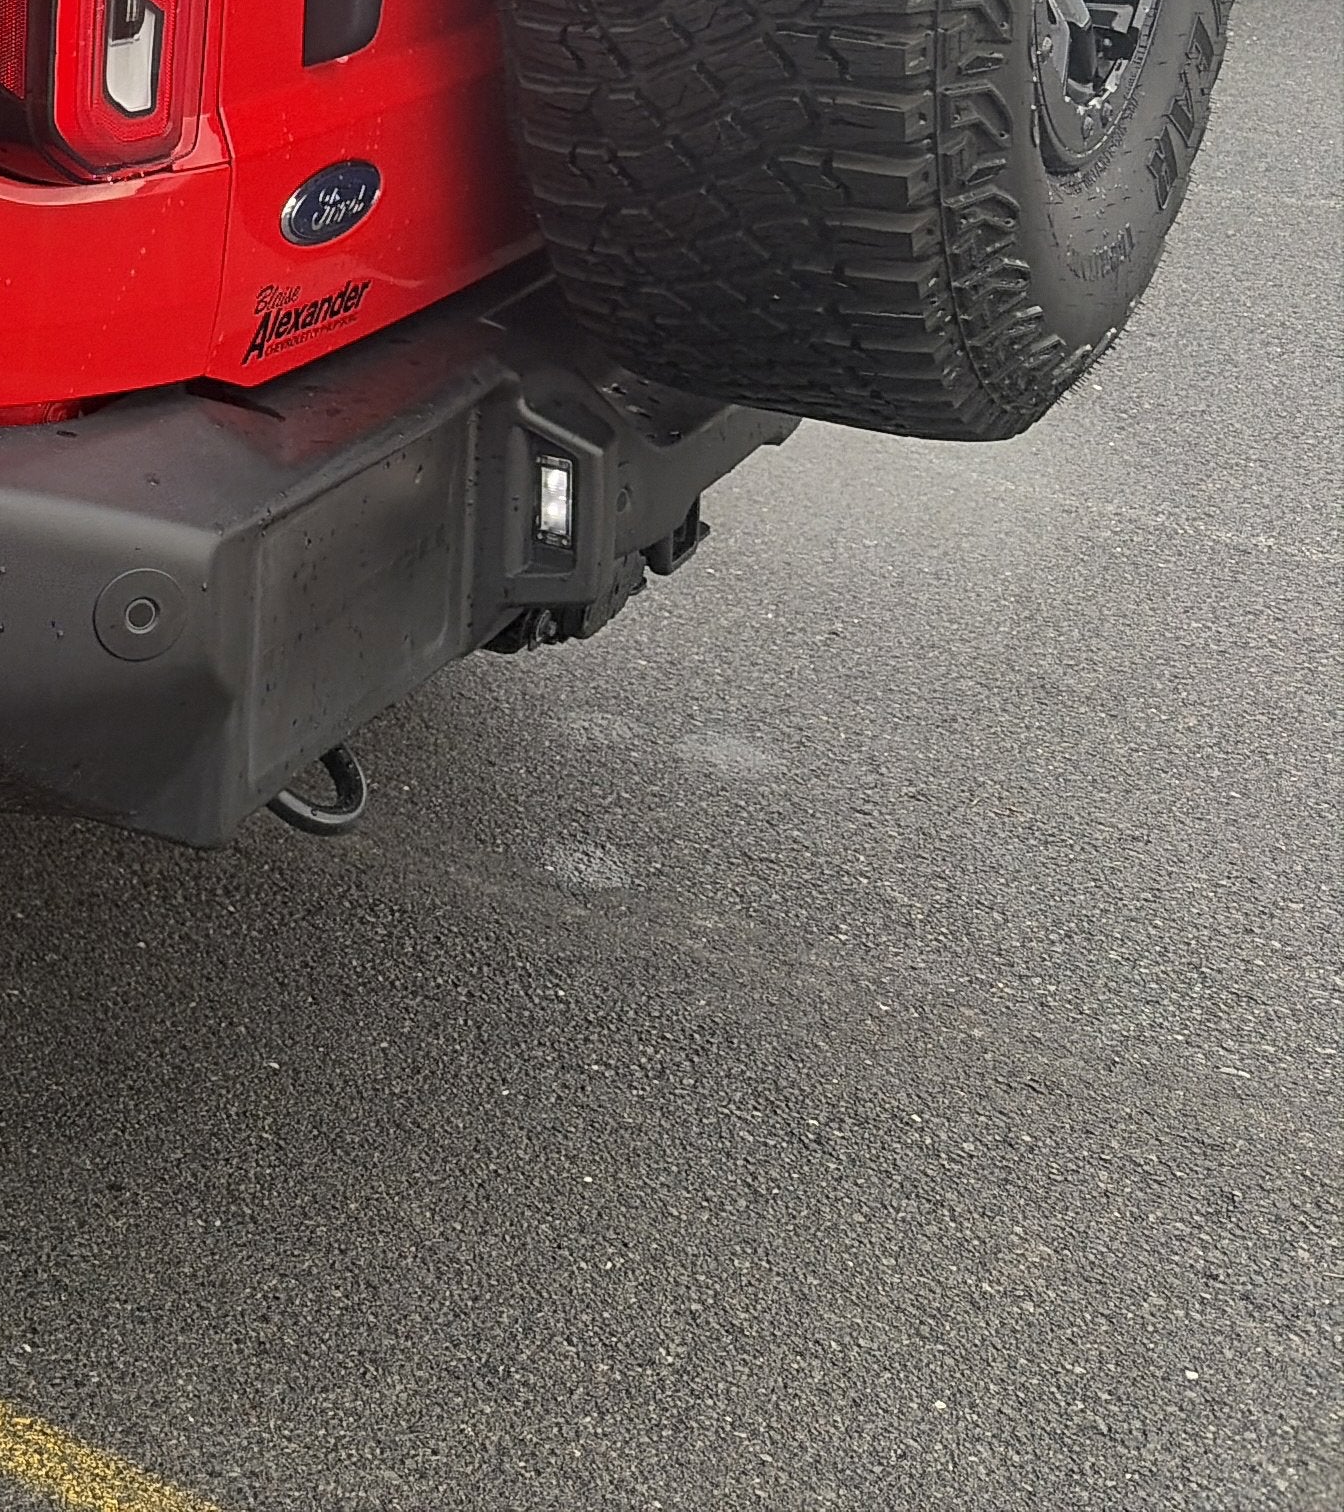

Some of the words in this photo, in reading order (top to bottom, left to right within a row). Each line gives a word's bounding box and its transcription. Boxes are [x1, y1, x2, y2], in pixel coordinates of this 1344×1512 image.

[311, 185, 367, 230] Ford
[241, 279, 372, 366] Alexander
[254, 284, 301, 316] Blaise
